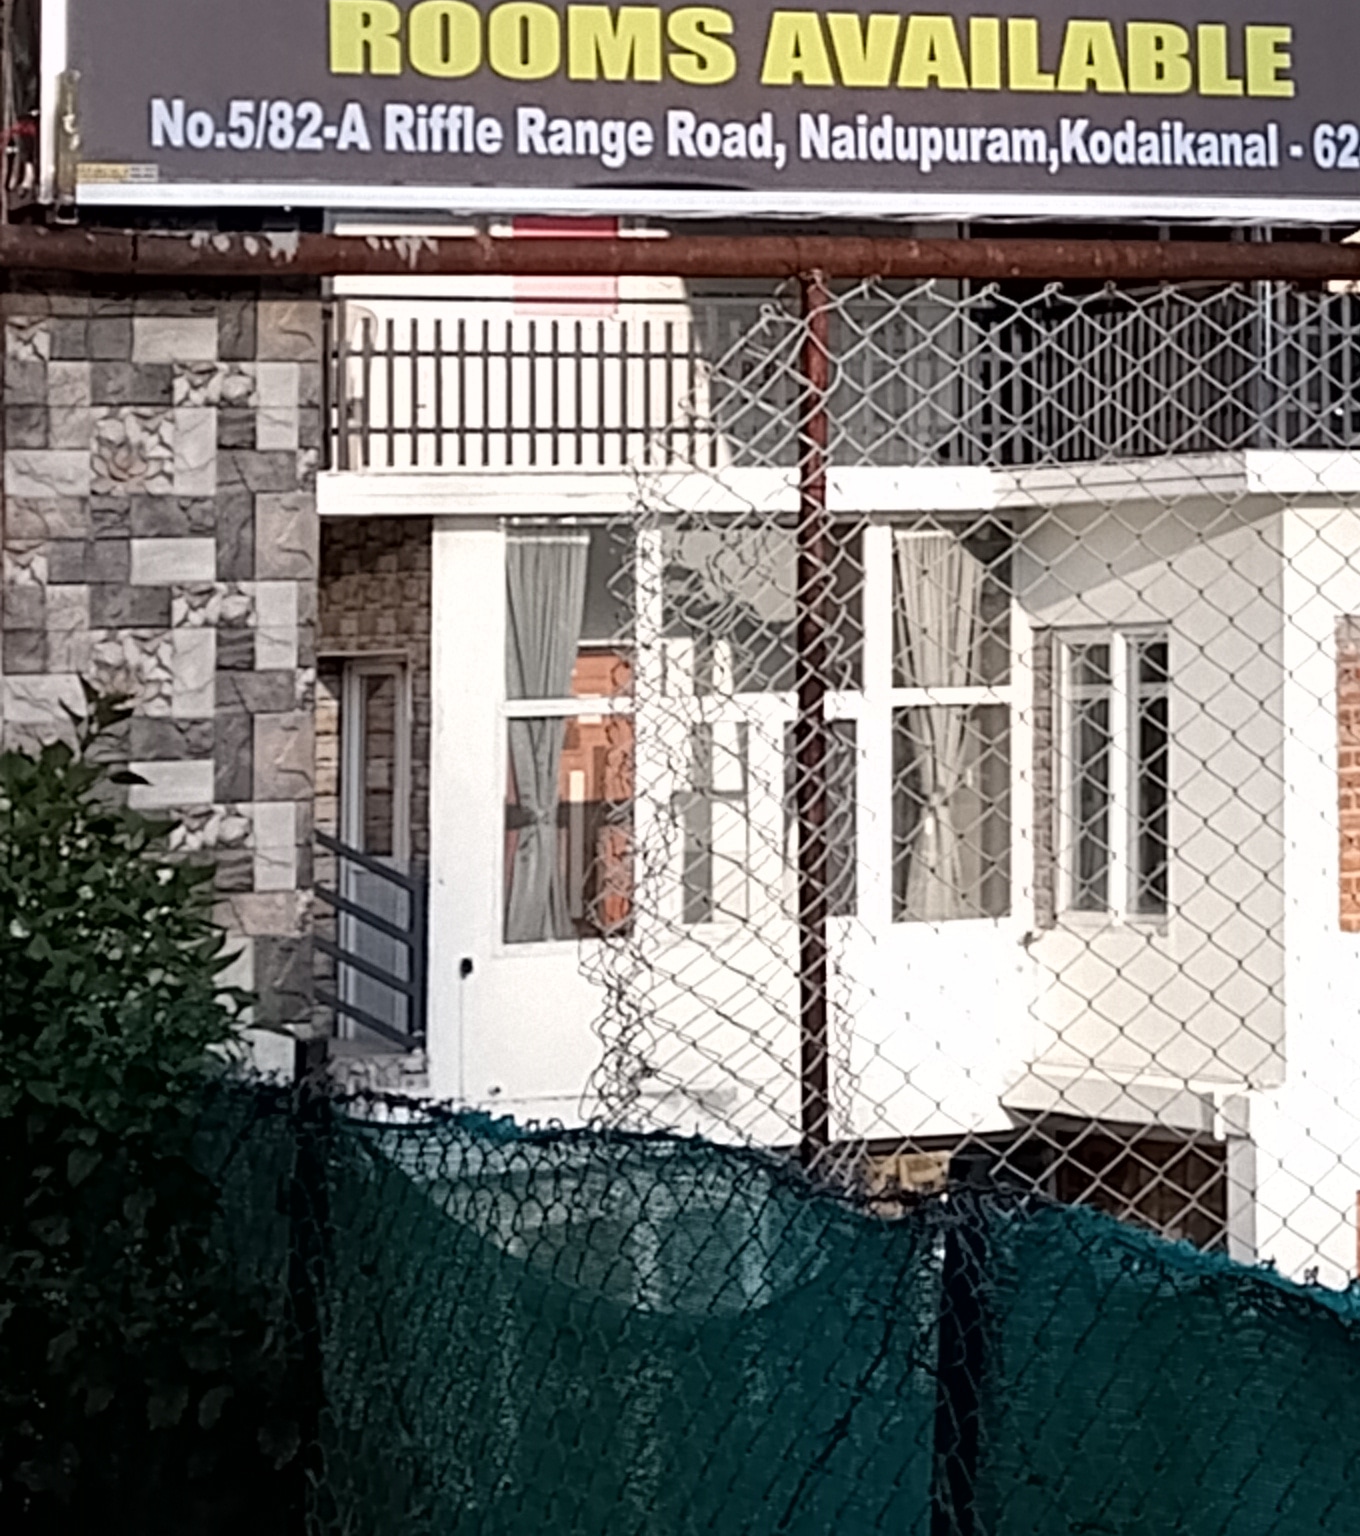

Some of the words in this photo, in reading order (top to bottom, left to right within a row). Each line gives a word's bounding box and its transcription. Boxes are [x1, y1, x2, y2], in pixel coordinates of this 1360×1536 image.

[761, 11, 1295, 98] AVAILABLE
[150, 96, 372, 150] No.5/82-A
[384, 105, 503, 154] Riffle
[516, 108, 654, 166] Range
[667, 110, 787, 170] Road,
